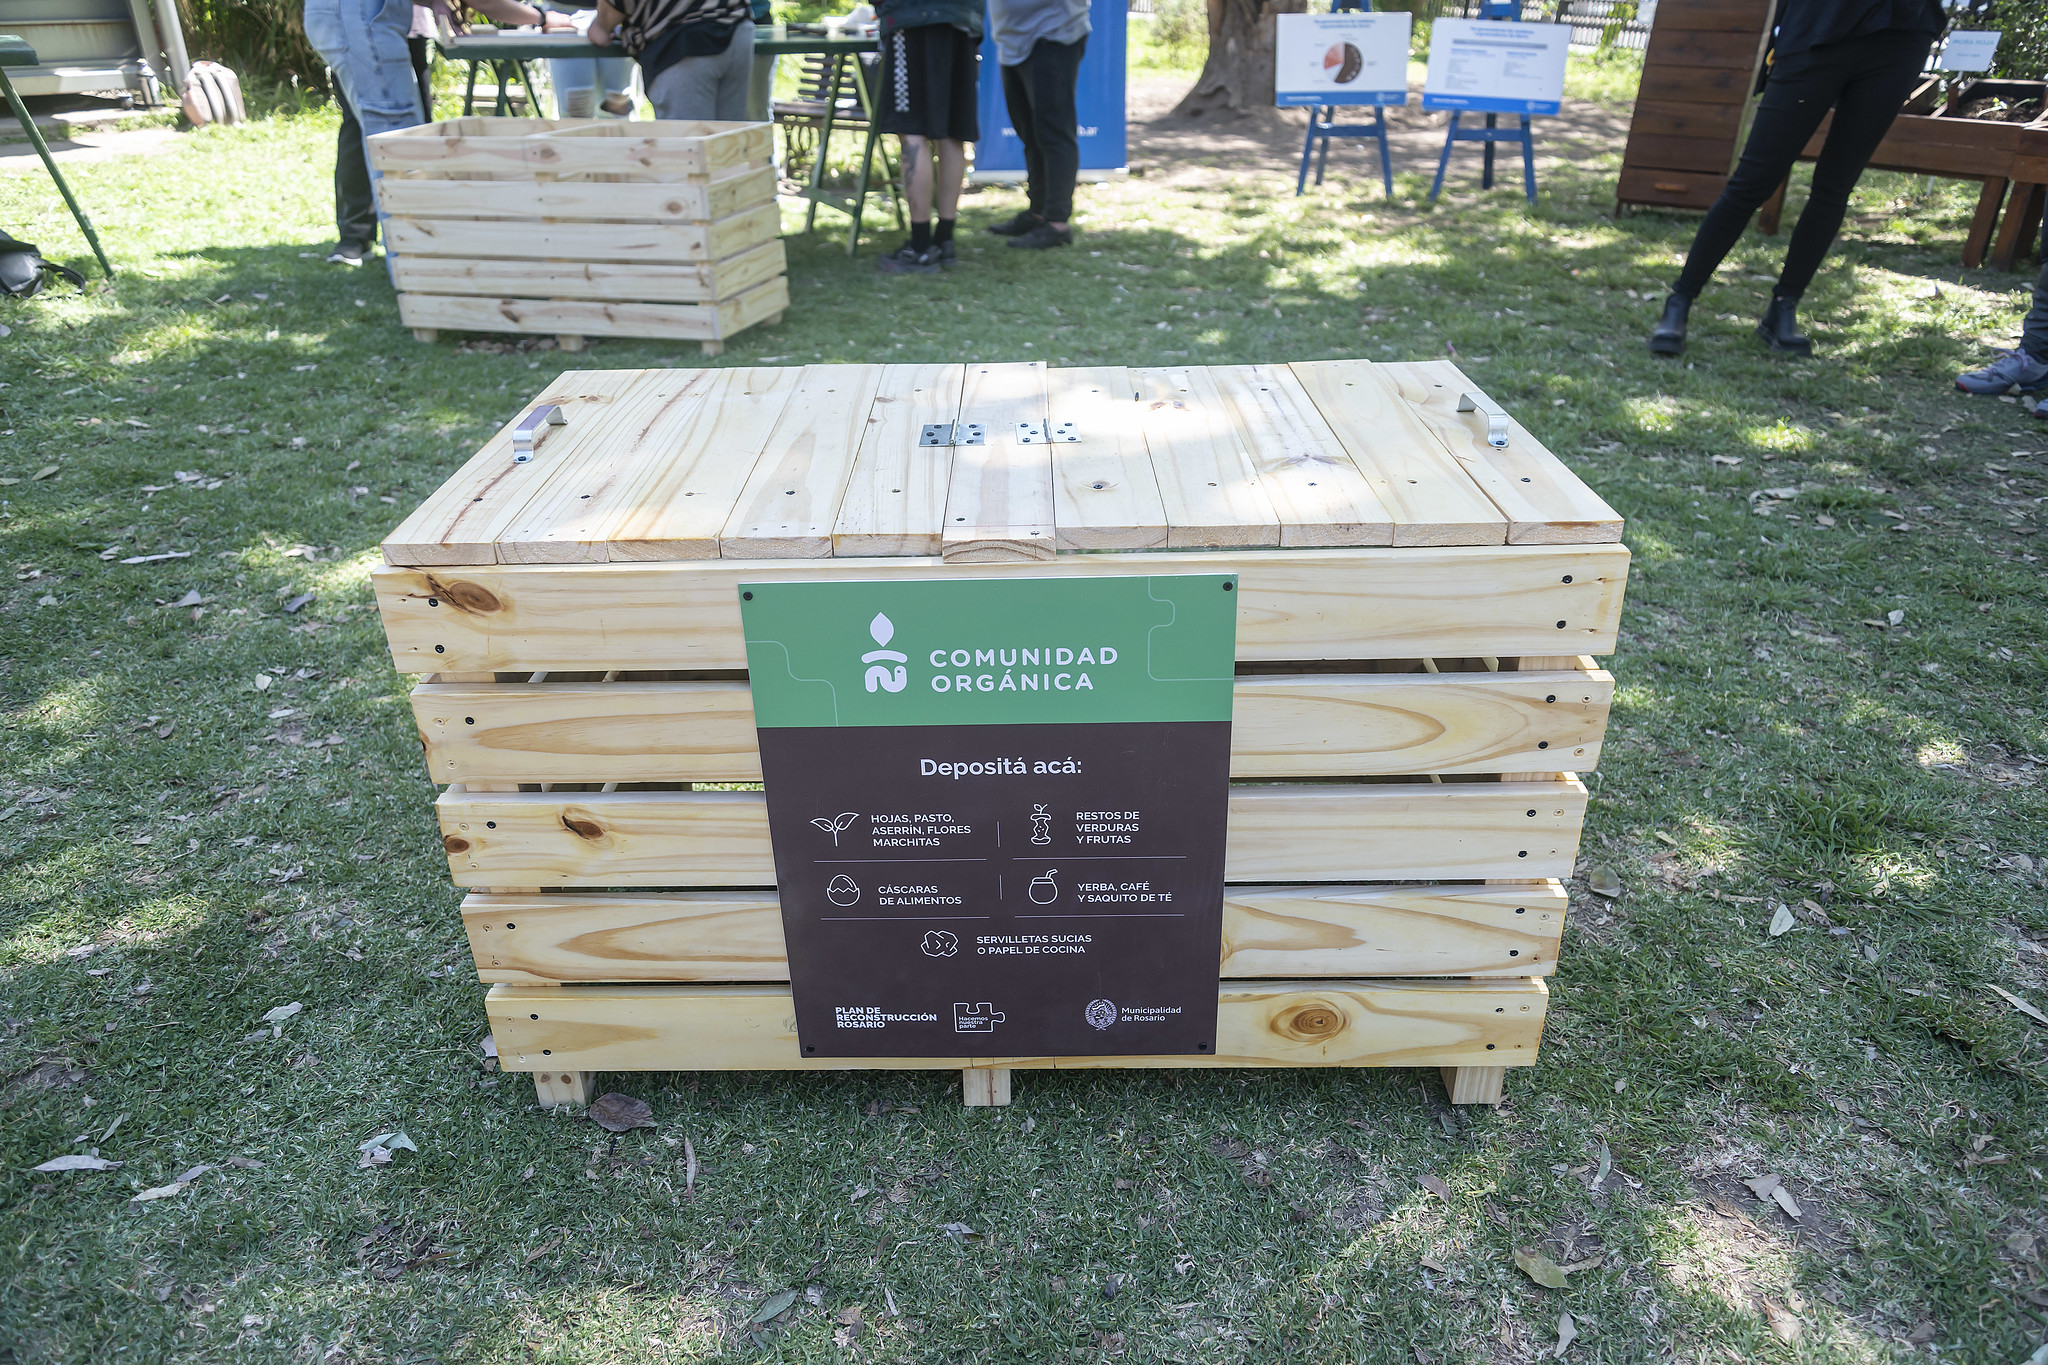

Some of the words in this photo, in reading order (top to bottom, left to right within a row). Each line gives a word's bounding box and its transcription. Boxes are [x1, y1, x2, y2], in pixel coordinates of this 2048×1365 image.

[930, 647, 1118, 667] COMUNIDAD
[932, 669, 1093, 692] ORGÁNICA
[920, 756, 1028, 780] Depositá
[1033, 756, 1082, 775] acá:
[870, 814, 912, 824] HOJAS,
[914, 813, 955, 823] PASTO,
[1076, 811, 1122, 821] RESTOS
[1124, 811, 1140, 820] DE
[871, 823, 925, 836] ASERRÍN,
[927, 825, 972, 835] FLORES
[1075, 823, 1140, 833] VERDURAS
[872, 837, 941, 847] MARCHITAS
[1075, 835, 1085, 844] Y
[1086, 834, 1132, 844] FRUTAS
[877, 883, 939, 895] CÁSCARAS
[1077, 882, 1118, 892] YERBA,
[1120, 880, 1150, 891] CAFÉ
[879, 897, 895, 906] DE
[896, 896, 963, 906] ALIMENTOS
[1077, 894, 1086, 903] Y
[1087, 893, 1138, 903] SAQUITO
[1140, 893, 1156, 902] DE
[1157, 891, 1173, 902] TÉ
[976, 934, 1049, 944] SERVILLETAS
[1051, 934, 1093, 943] SUCIAS
[976, 946, 986, 955] O
[988, 946, 1024, 955] PAPEL
[1024, 945, 1040, 954] DE
[1041, 945, 1086, 954] COCINA
[1121, 1007, 1182, 1015] Municipalidad
[836, 1013, 937, 1021] RECONSTRUCCIÓN
